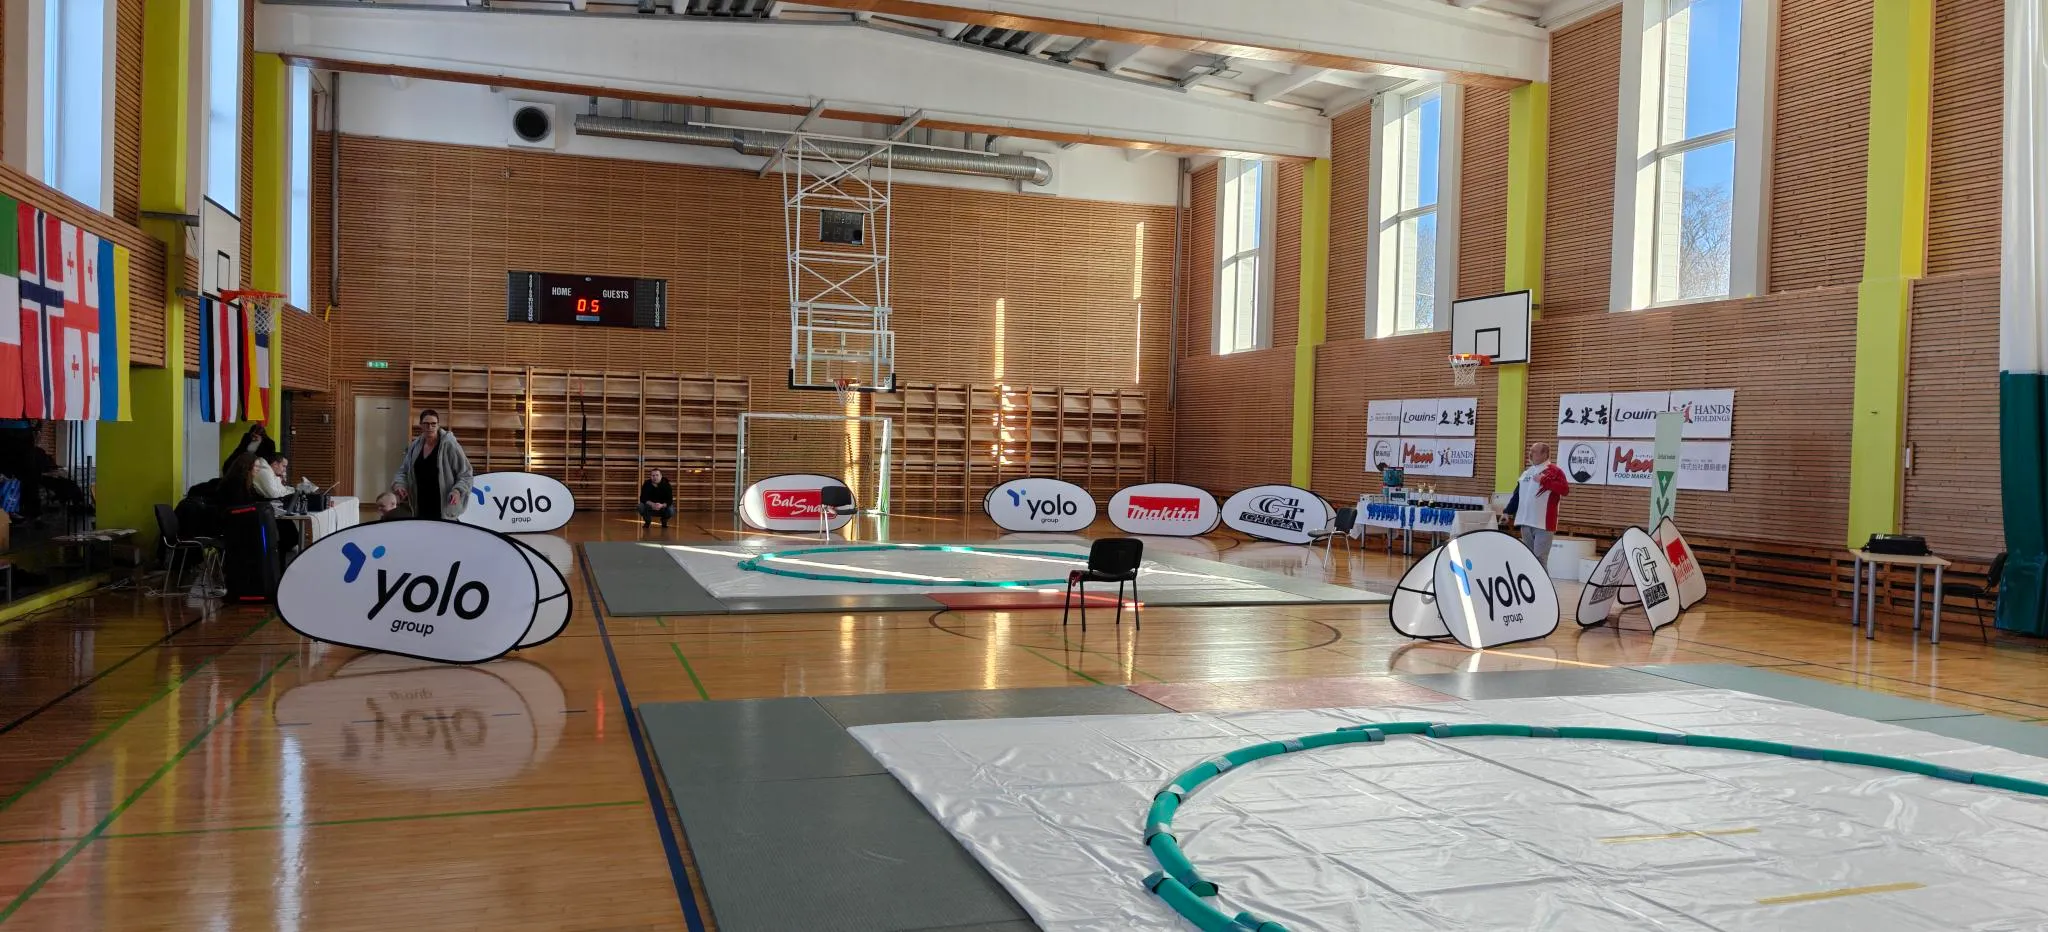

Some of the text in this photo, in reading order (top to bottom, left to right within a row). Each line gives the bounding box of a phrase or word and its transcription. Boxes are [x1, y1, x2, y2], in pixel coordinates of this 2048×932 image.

[552, 287, 572, 296] HOME
[602, 290, 629, 299] GUESTS
[1560, 404, 1608, 426] 久米吉
[1615, 408, 1666, 422] Lowin
[1694, 404, 1731, 415] HANDS
[1403, 411, 1436, 423] Lowins
[1439, 408, 1475, 426] 久米吉
[1694, 415, 1731, 423] HOLDINGS
[1450, 450, 1473, 459] HANDS
[492, 487, 552, 520] yolo
[767, 493, 794, 507] Bal
[1026, 493, 1077, 520] yolo
[367, 560, 490, 621] yolo
[1475, 561, 1536, 621] yolo
[1502, 611, 1524, 626] group
[390, 618, 434, 637] group
